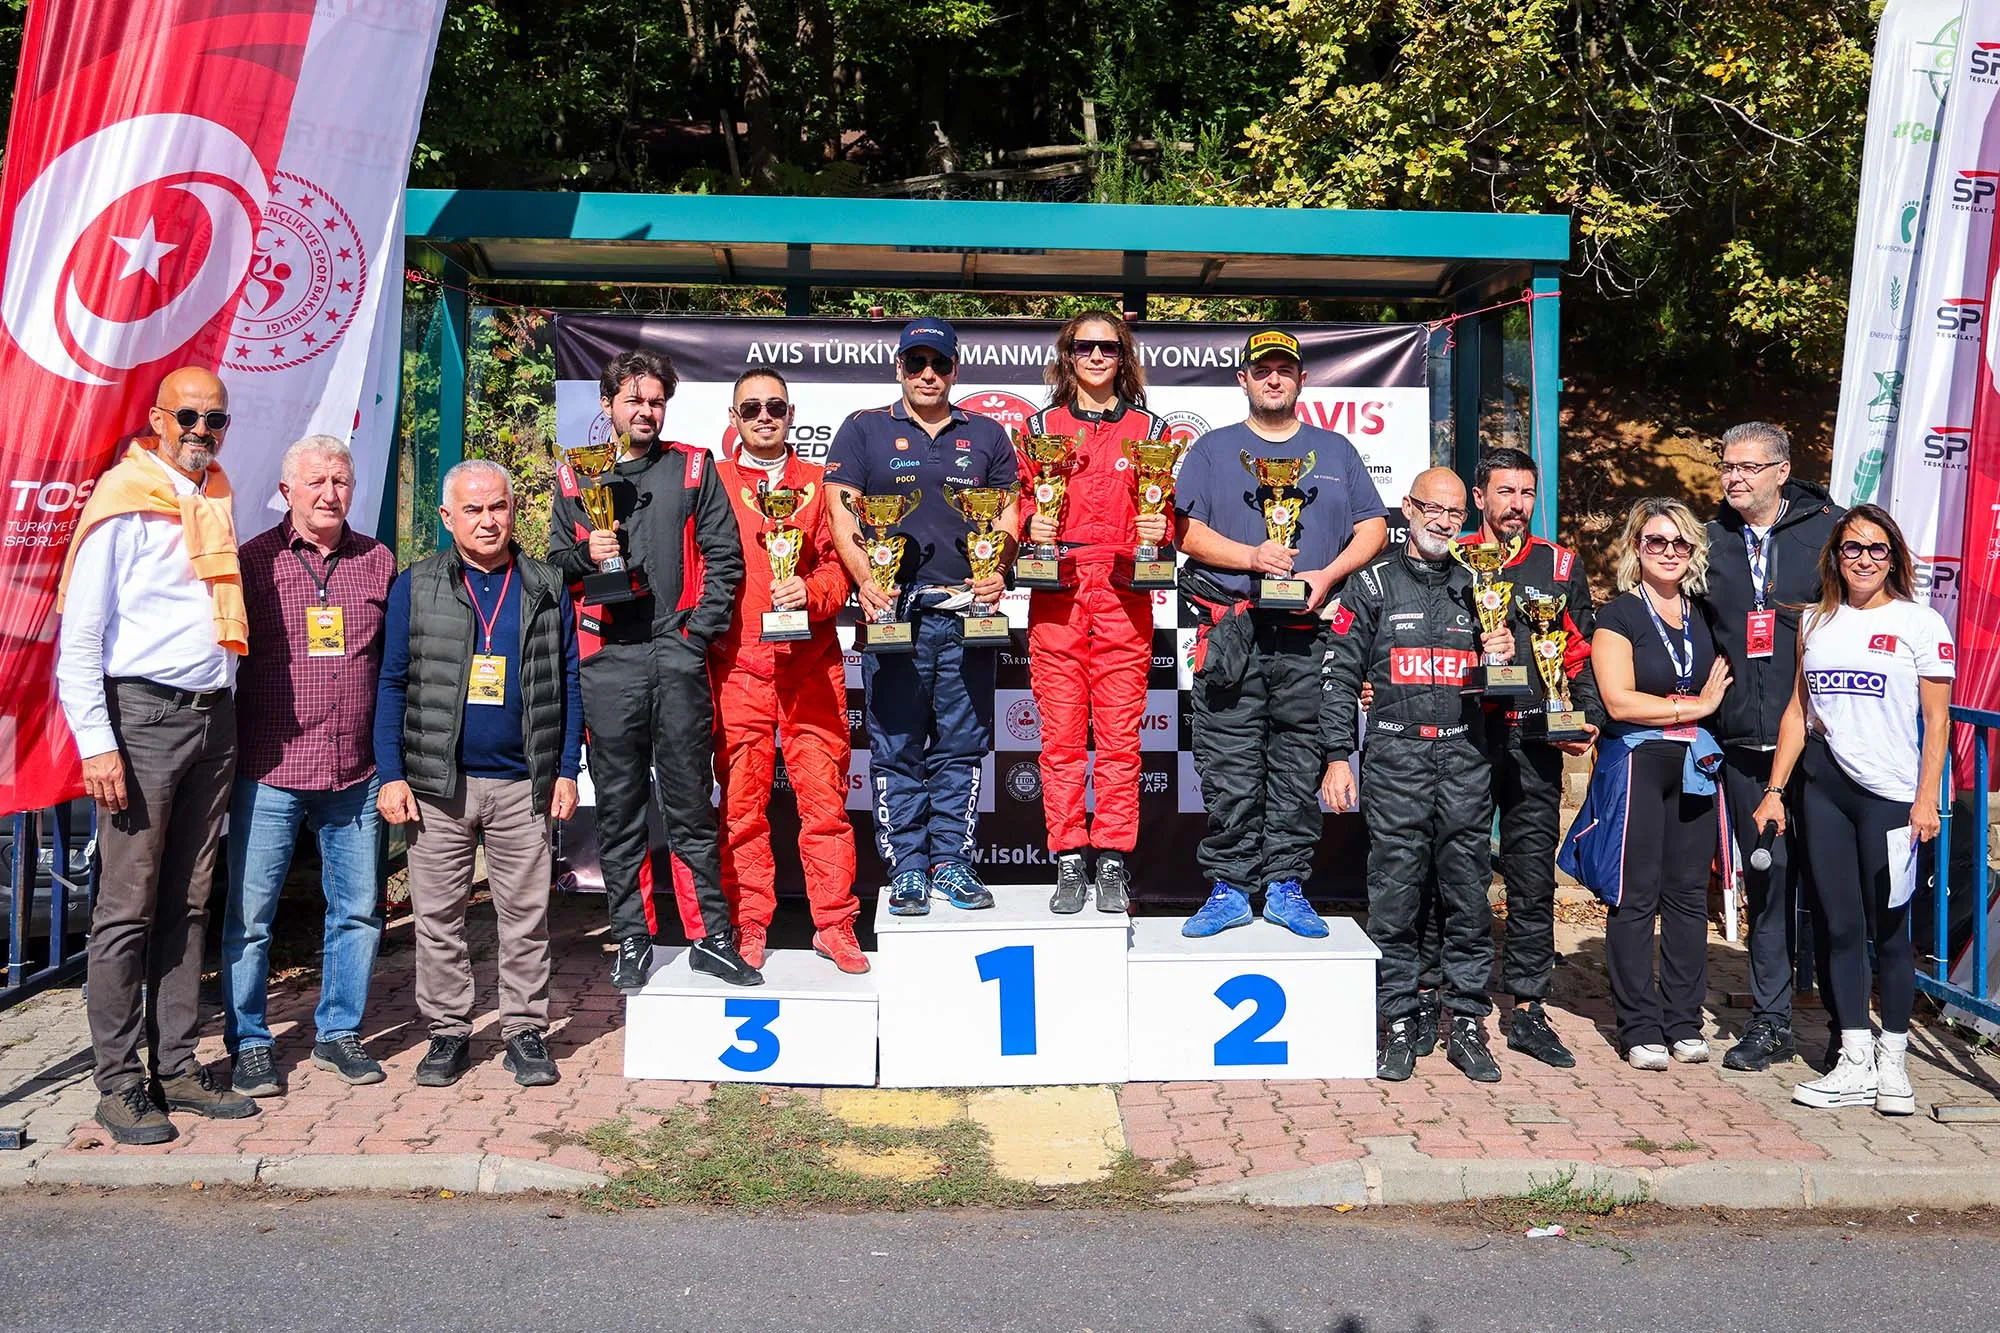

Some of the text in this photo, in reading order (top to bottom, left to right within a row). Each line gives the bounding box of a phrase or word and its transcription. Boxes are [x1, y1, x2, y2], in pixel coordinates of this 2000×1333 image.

[304, 229, 320, 248] VE
[313, 248, 328, 284] SPOR
[266, 285, 325, 335] BAKANLIĞI
[746, 342, 803, 364] AVIS
[1924, 435, 1968, 460] SP
[895, 475, 916, 484] POCO
[7, 519, 69, 533] TÜRKİYE
[1808, 672, 1884, 694] sparco
[1378, 720, 1405, 732] sparco
[1144, 783, 1168, 793] APP
[975, 945, 1036, 1057] 1
[1213, 973, 1289, 1067] 2
[718, 998, 781, 1073] 3
